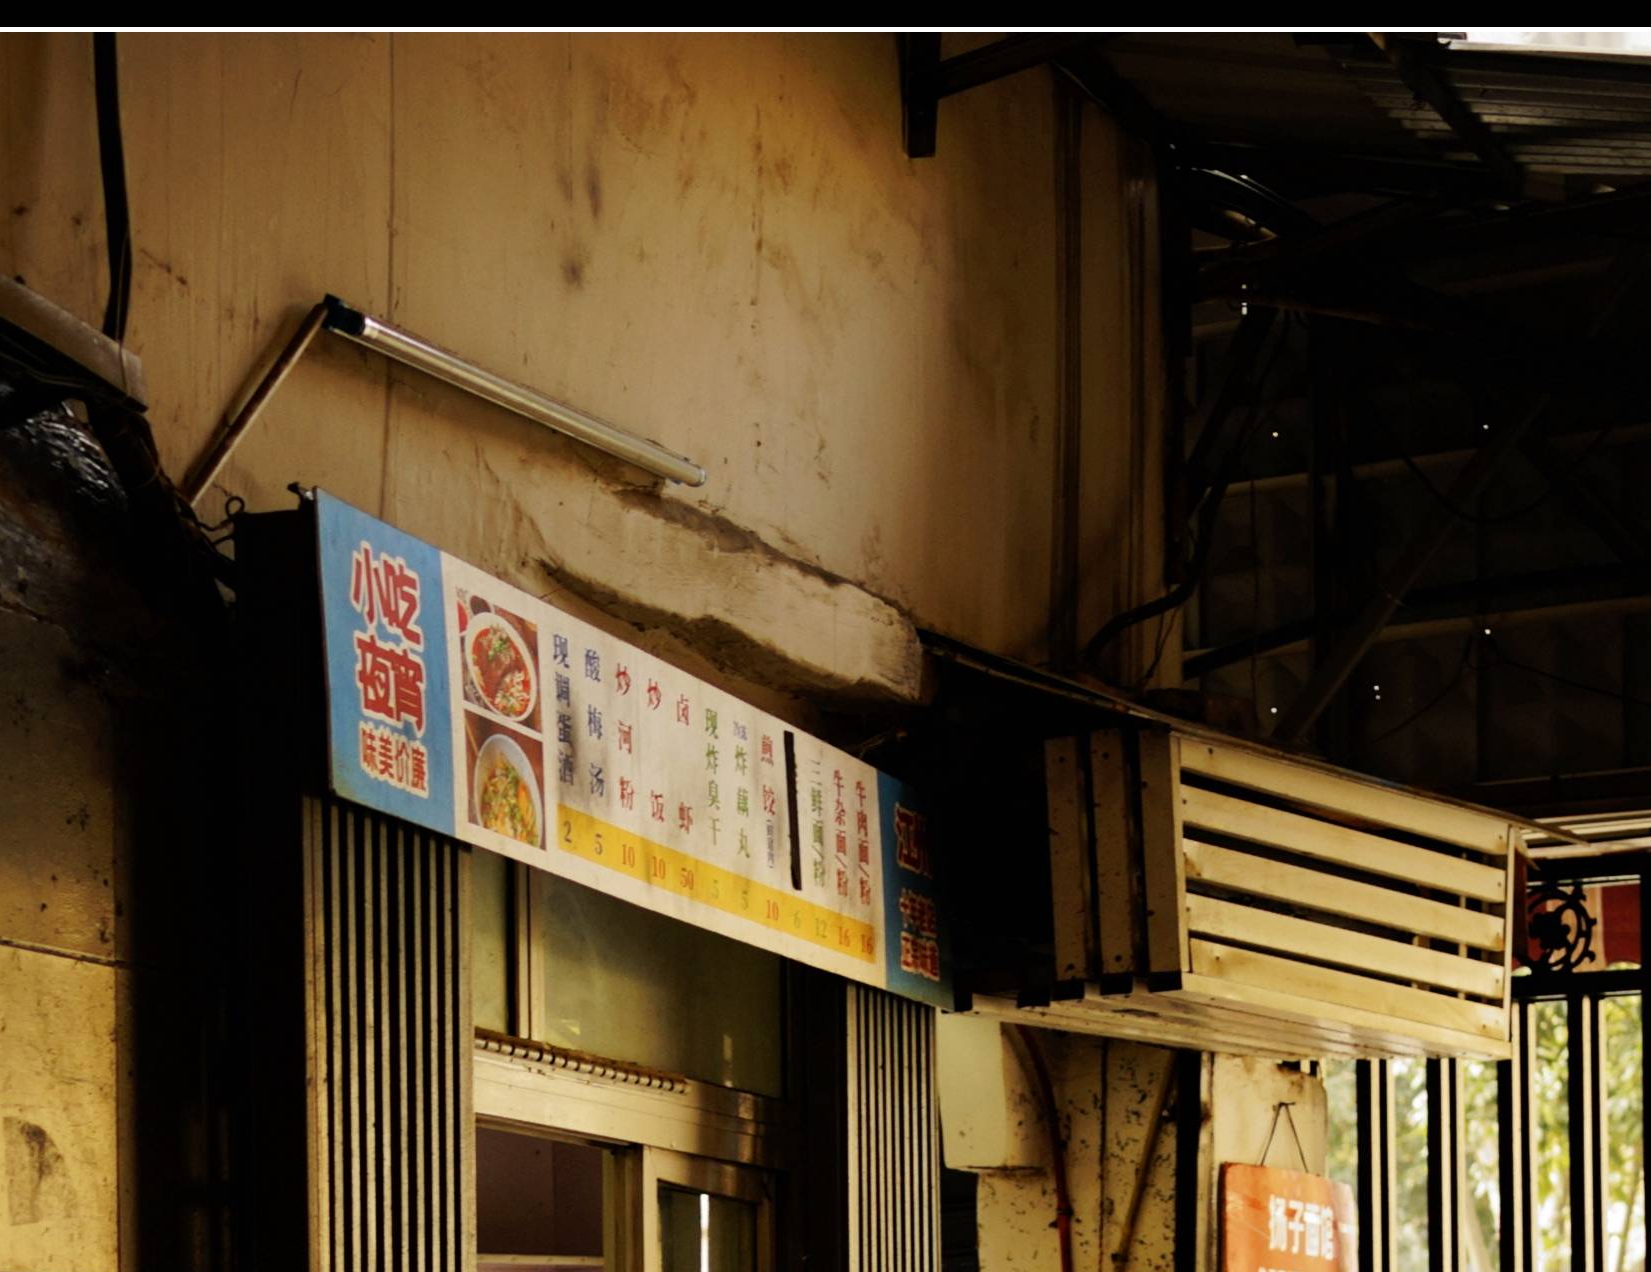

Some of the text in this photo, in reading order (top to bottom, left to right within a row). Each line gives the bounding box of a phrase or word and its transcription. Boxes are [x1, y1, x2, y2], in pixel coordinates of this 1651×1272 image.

[351, 543, 423, 650] 小吃
[354, 632, 426, 737] 夜宵
[359, 721, 429, 798] 味美价廉
